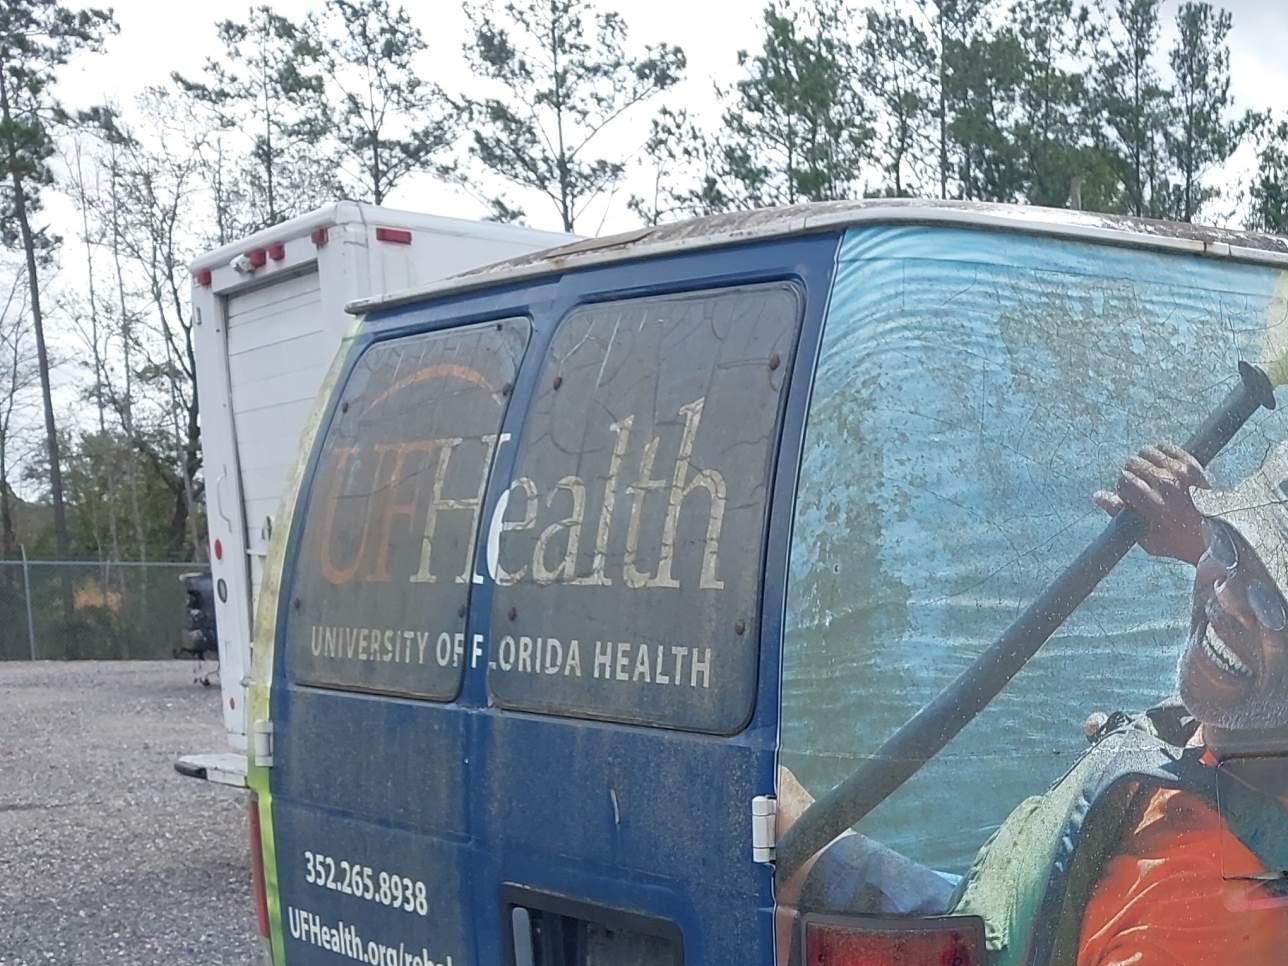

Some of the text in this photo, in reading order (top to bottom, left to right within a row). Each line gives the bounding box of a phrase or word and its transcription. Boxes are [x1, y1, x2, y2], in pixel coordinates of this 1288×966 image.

[311, 625, 712, 689] UNIVERSITY OF FORIDA HEALTH
[304, 850, 429, 917] 352.265.8938
